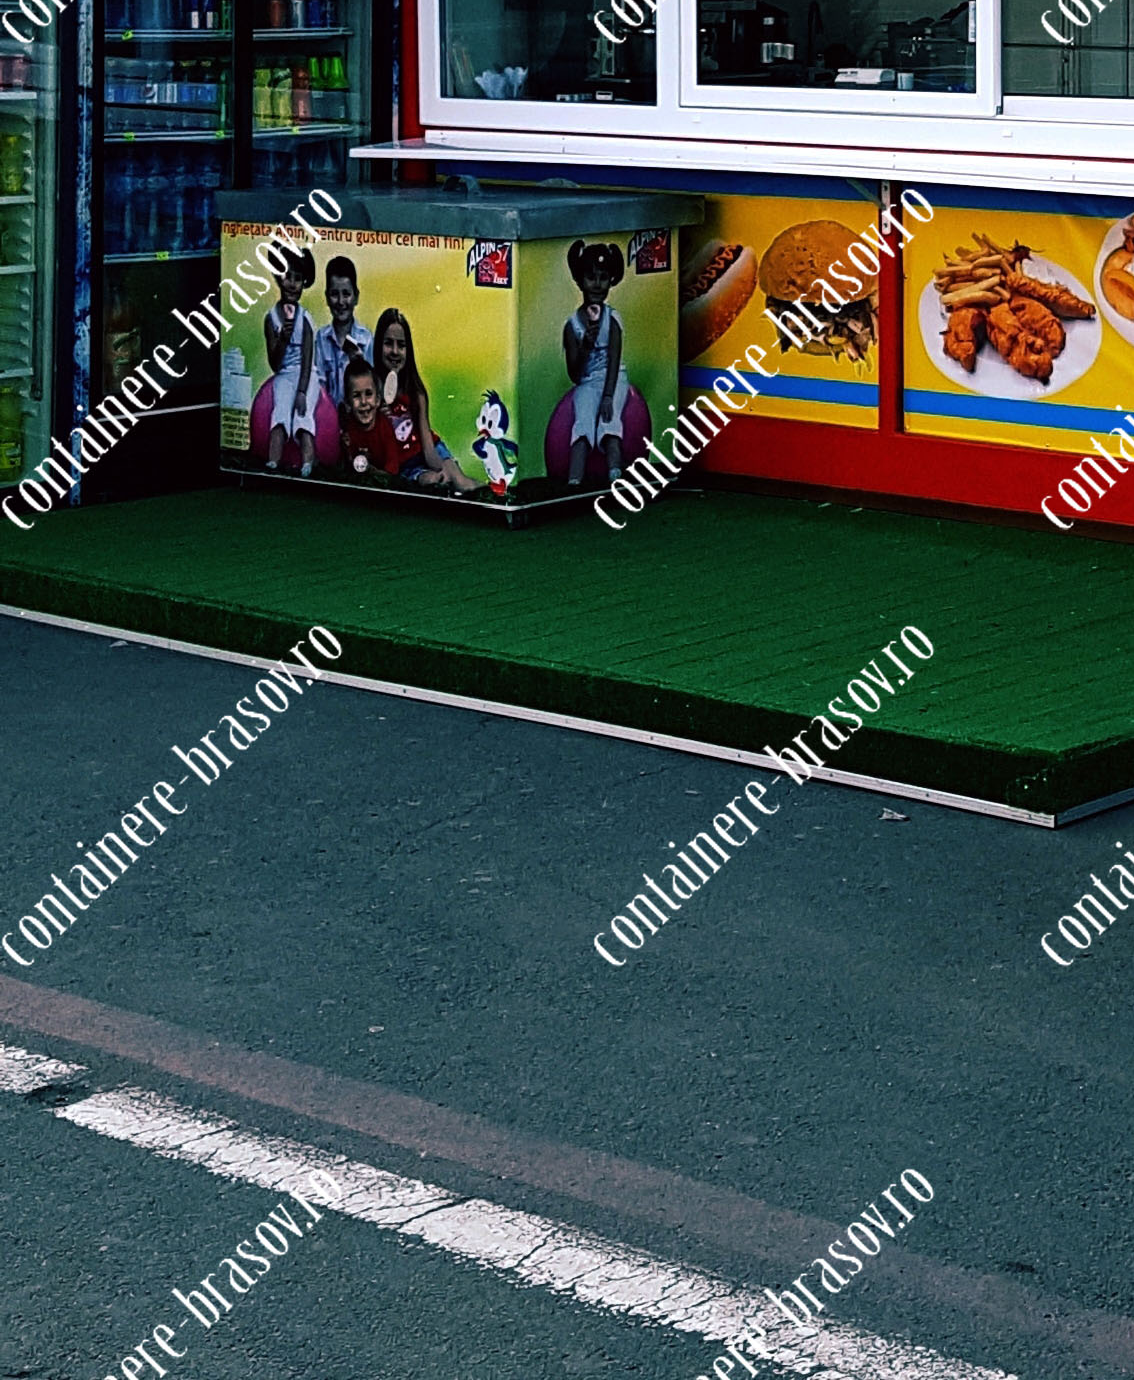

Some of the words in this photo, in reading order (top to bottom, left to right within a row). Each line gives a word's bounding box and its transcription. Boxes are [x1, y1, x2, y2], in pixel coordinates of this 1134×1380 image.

[313, 226, 352, 243] pentru
[356, 230, 392, 246] gustul
[396, 232, 414, 247] cel
[418, 236, 440, 248] mai
[469, 242, 496, 271] ALPIN
[494, 242, 512, 264] 57
